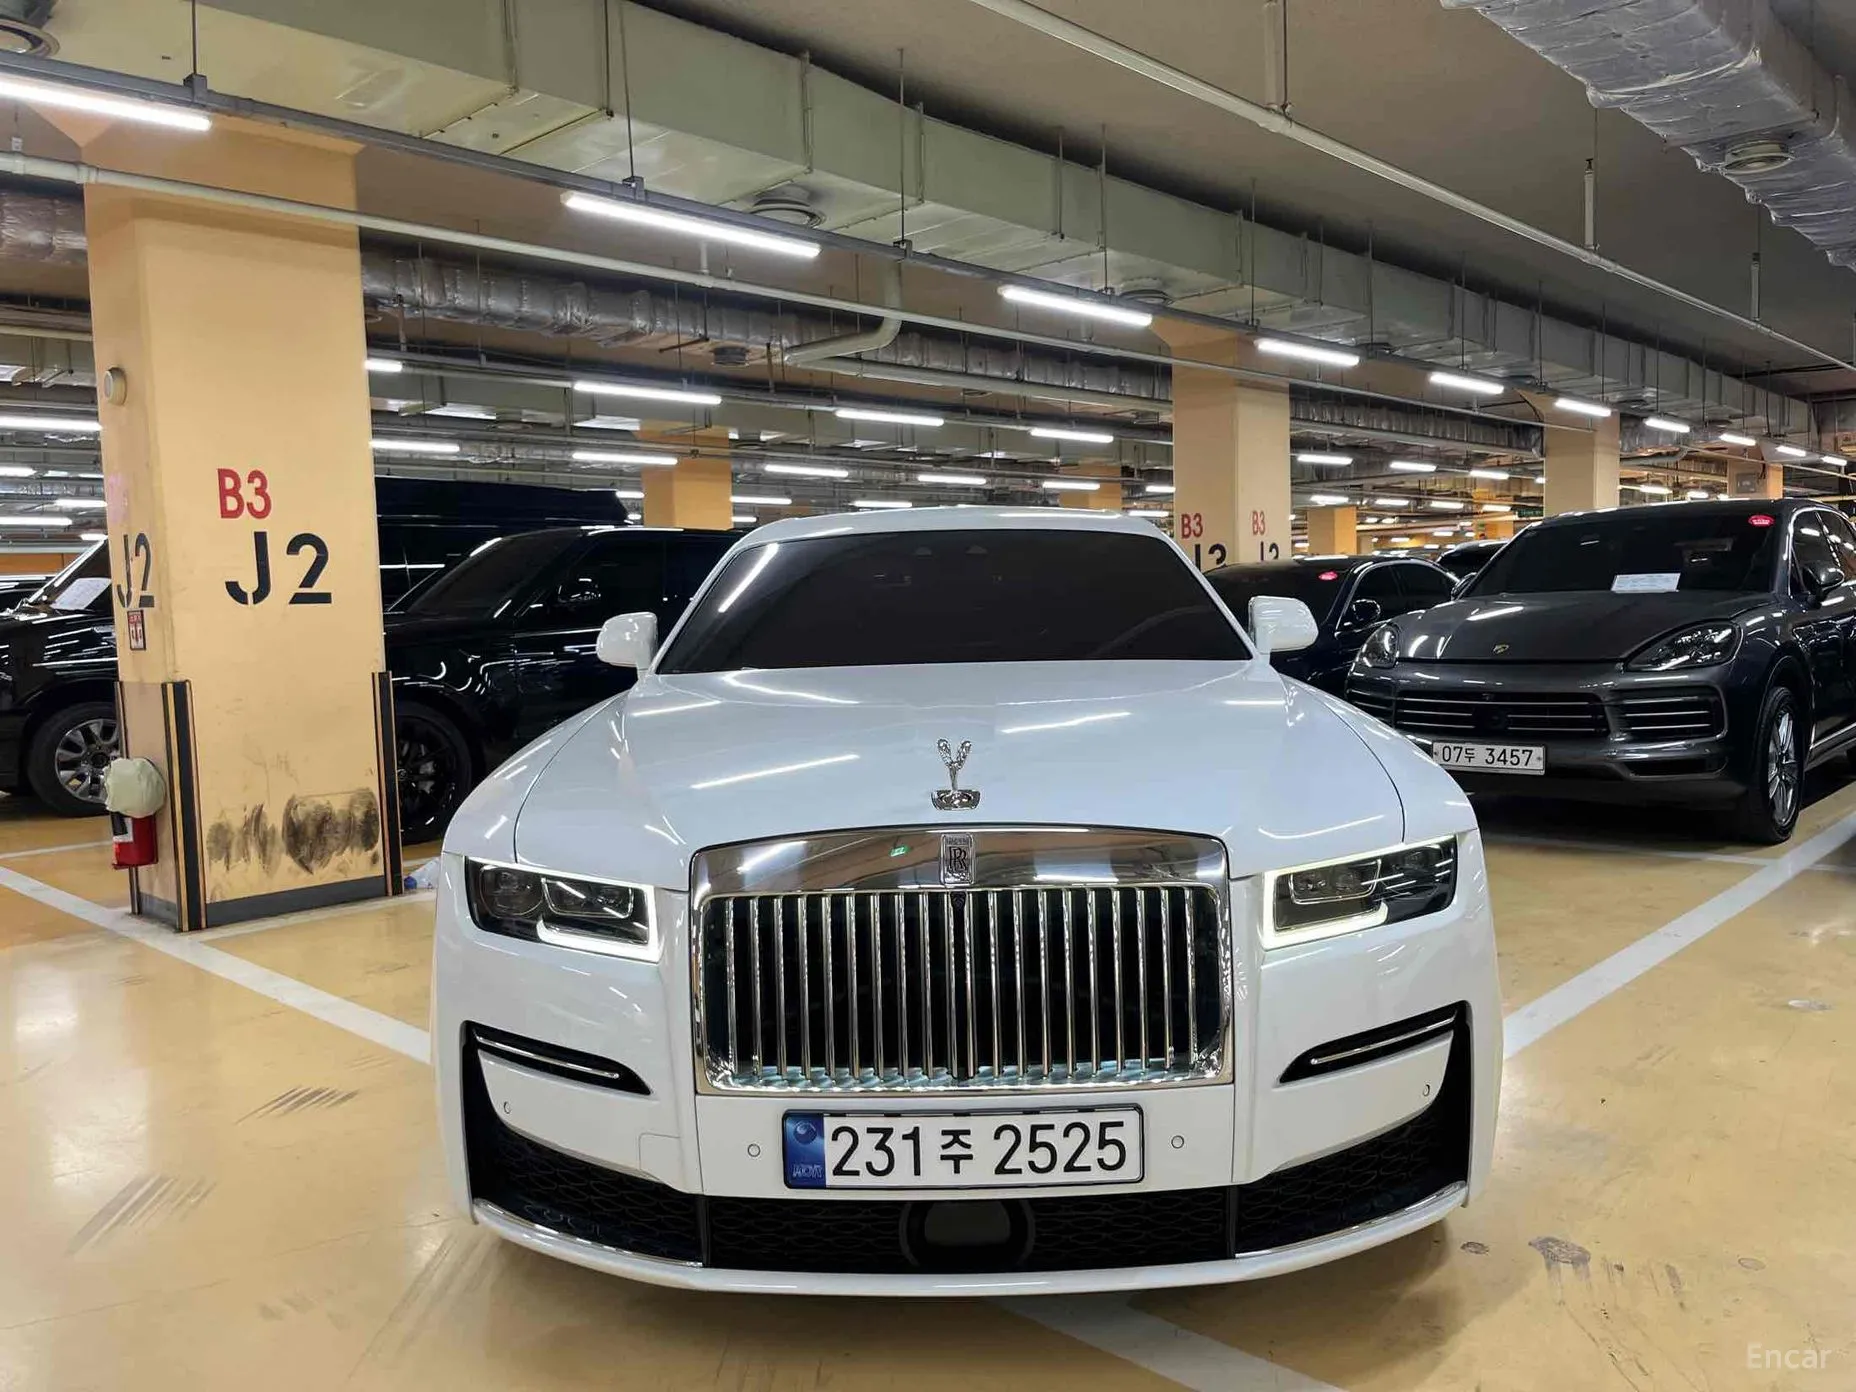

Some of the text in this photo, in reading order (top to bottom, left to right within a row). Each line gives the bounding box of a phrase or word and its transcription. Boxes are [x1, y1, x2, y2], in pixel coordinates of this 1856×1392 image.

[216, 468, 272, 519] B3
[1181, 513, 1203, 539] B3
[1252, 510, 1266, 535] B3
[116, 533, 155, 608] J2
[224, 531, 332, 605] J2
[1485, 748, 1533, 766] 3457
[993, 1120, 1126, 1175] 2525
